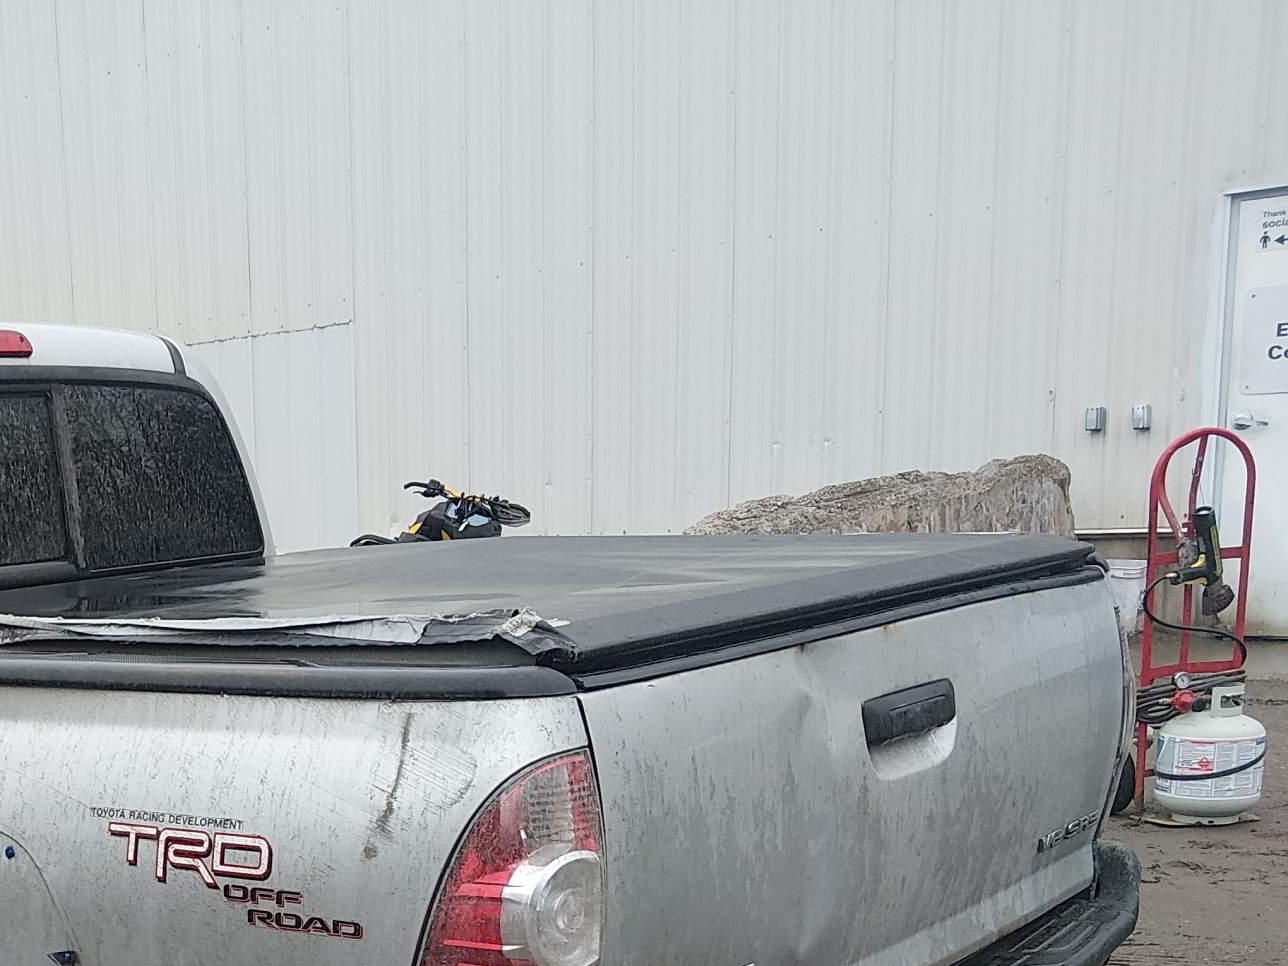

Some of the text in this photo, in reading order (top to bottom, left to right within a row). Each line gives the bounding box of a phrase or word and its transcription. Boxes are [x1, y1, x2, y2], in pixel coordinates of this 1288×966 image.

[1263, 210, 1287, 218] Thank
[90, 807, 244, 830] TOYOTA RACING DEVELOPMENT
[108, 821, 273, 889] TRD
[223, 883, 303, 908] OFF
[247, 908, 364, 940] ROAD
